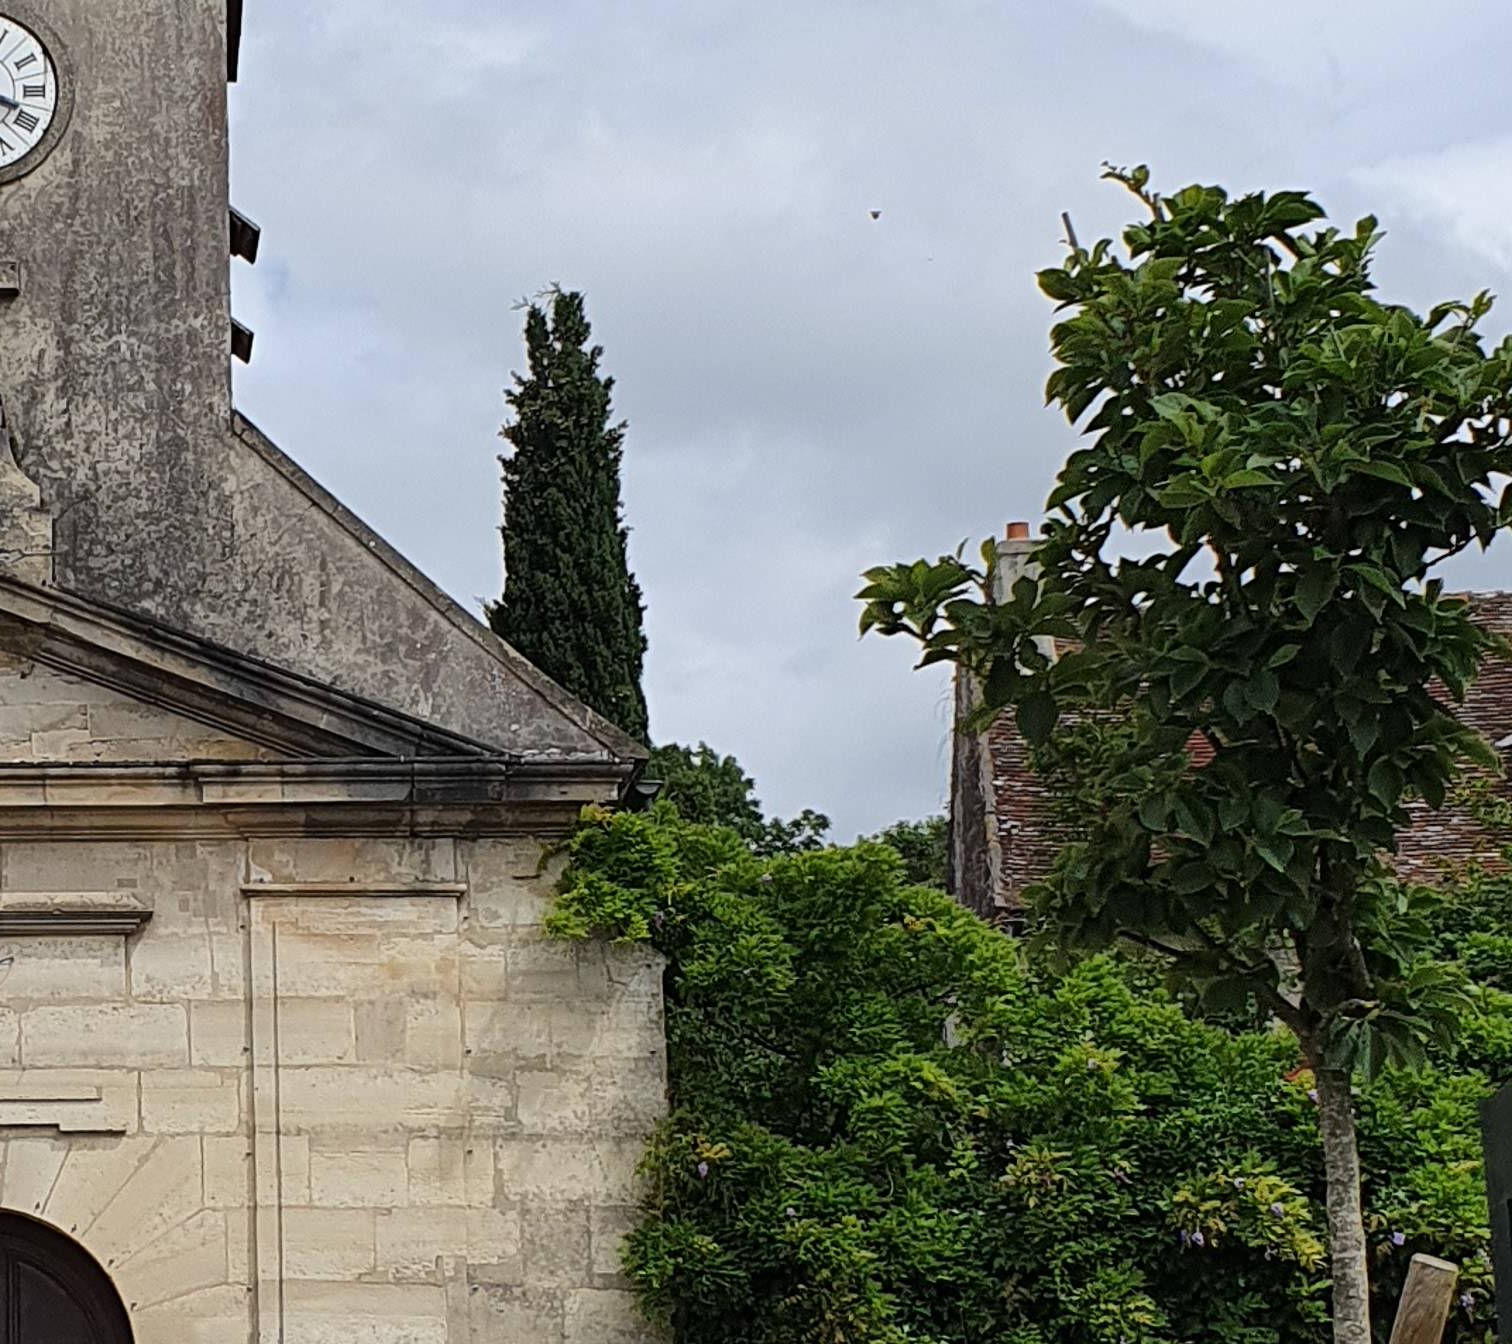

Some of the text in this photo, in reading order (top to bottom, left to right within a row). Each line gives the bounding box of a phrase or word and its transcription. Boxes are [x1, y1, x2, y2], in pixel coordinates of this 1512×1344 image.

[14, 53, 37, 71] II
[22, 84, 46, 99] III
[13, 109, 40, 134] IIII
